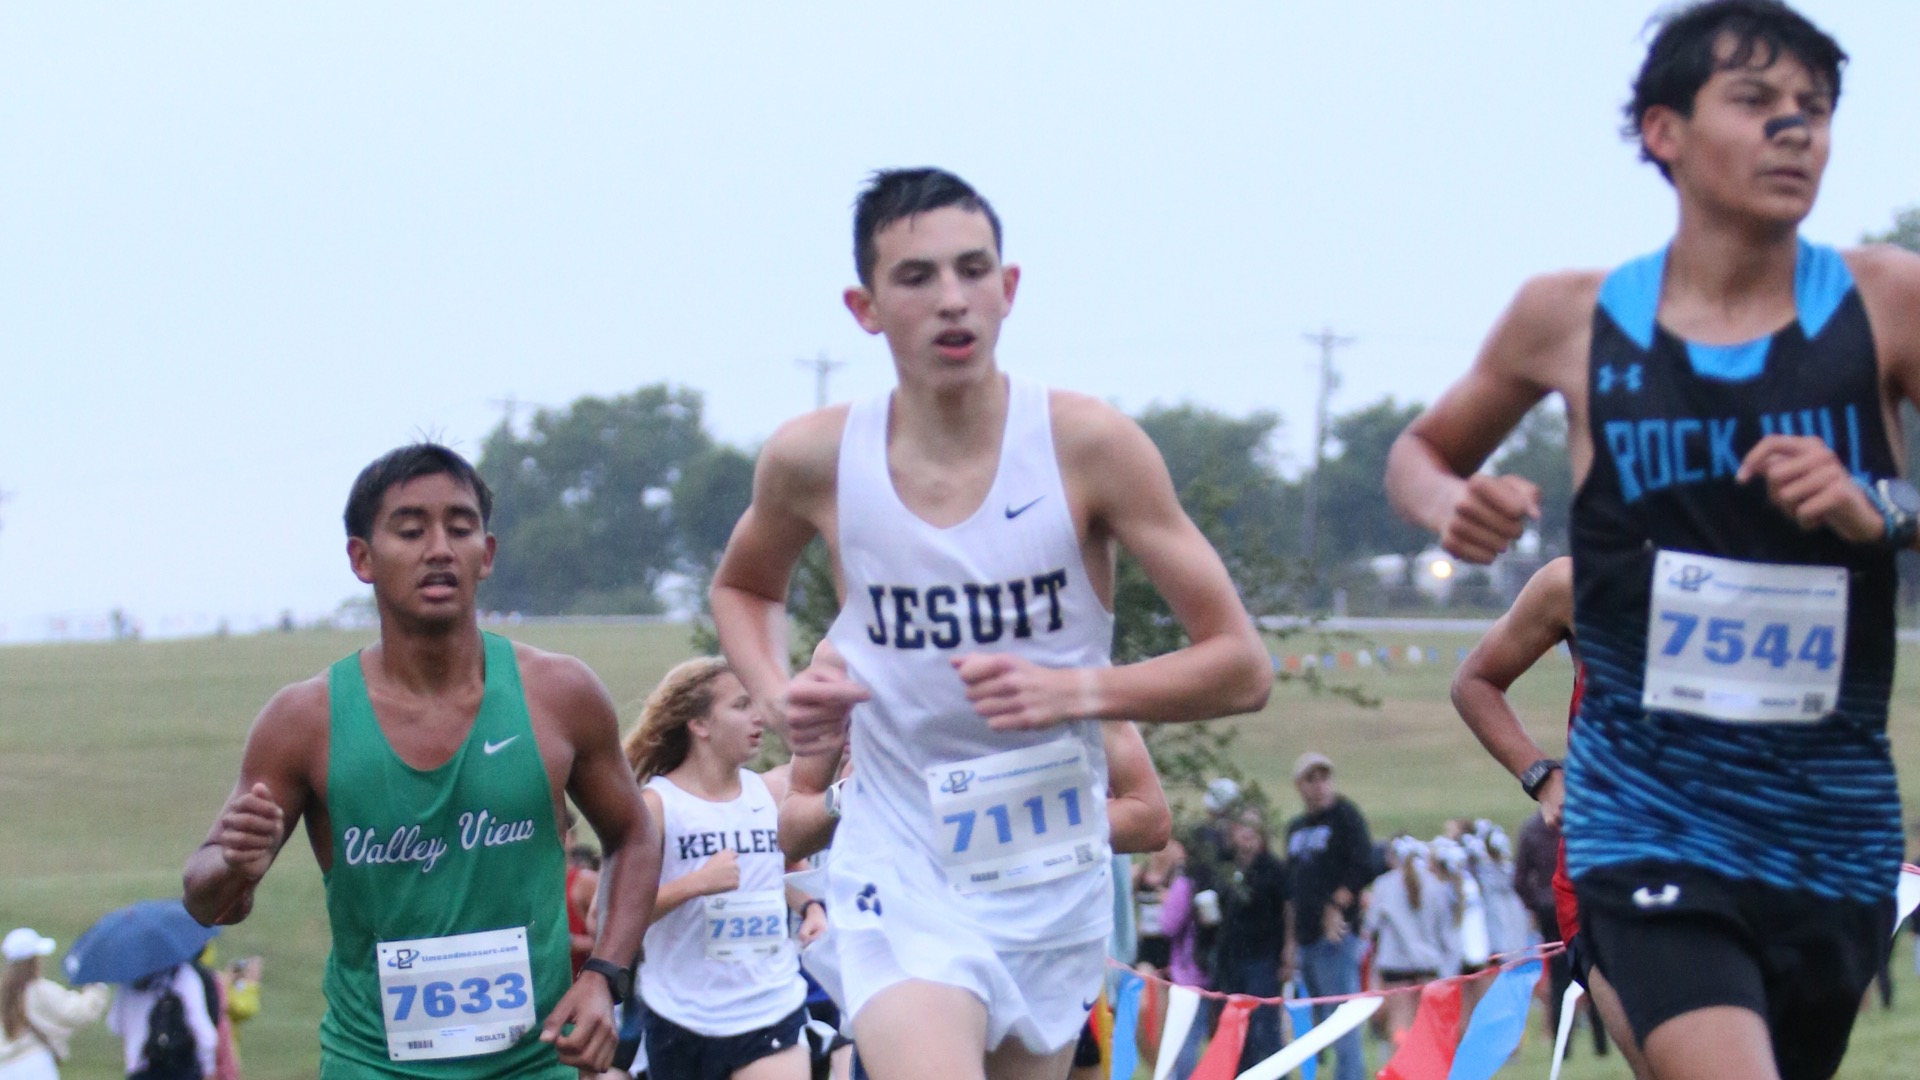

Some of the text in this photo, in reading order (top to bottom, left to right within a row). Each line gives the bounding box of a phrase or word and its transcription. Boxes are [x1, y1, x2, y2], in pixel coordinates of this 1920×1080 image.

[1604, 417, 1741, 504] ROCK
[867, 568, 1067, 649] JESUIT
[1660, 610, 1837, 670] 7544
[344, 808, 535, 873] Valley View
[678, 830, 778, 860] KELLER
[943, 787, 1082, 853] 7111
[421, 945, 519, 963] timeandmeasure.com
[709, 915, 779, 939] 7322
[387, 972, 528, 1021] 7633
[475, 1032, 506, 1042] RESULTS
